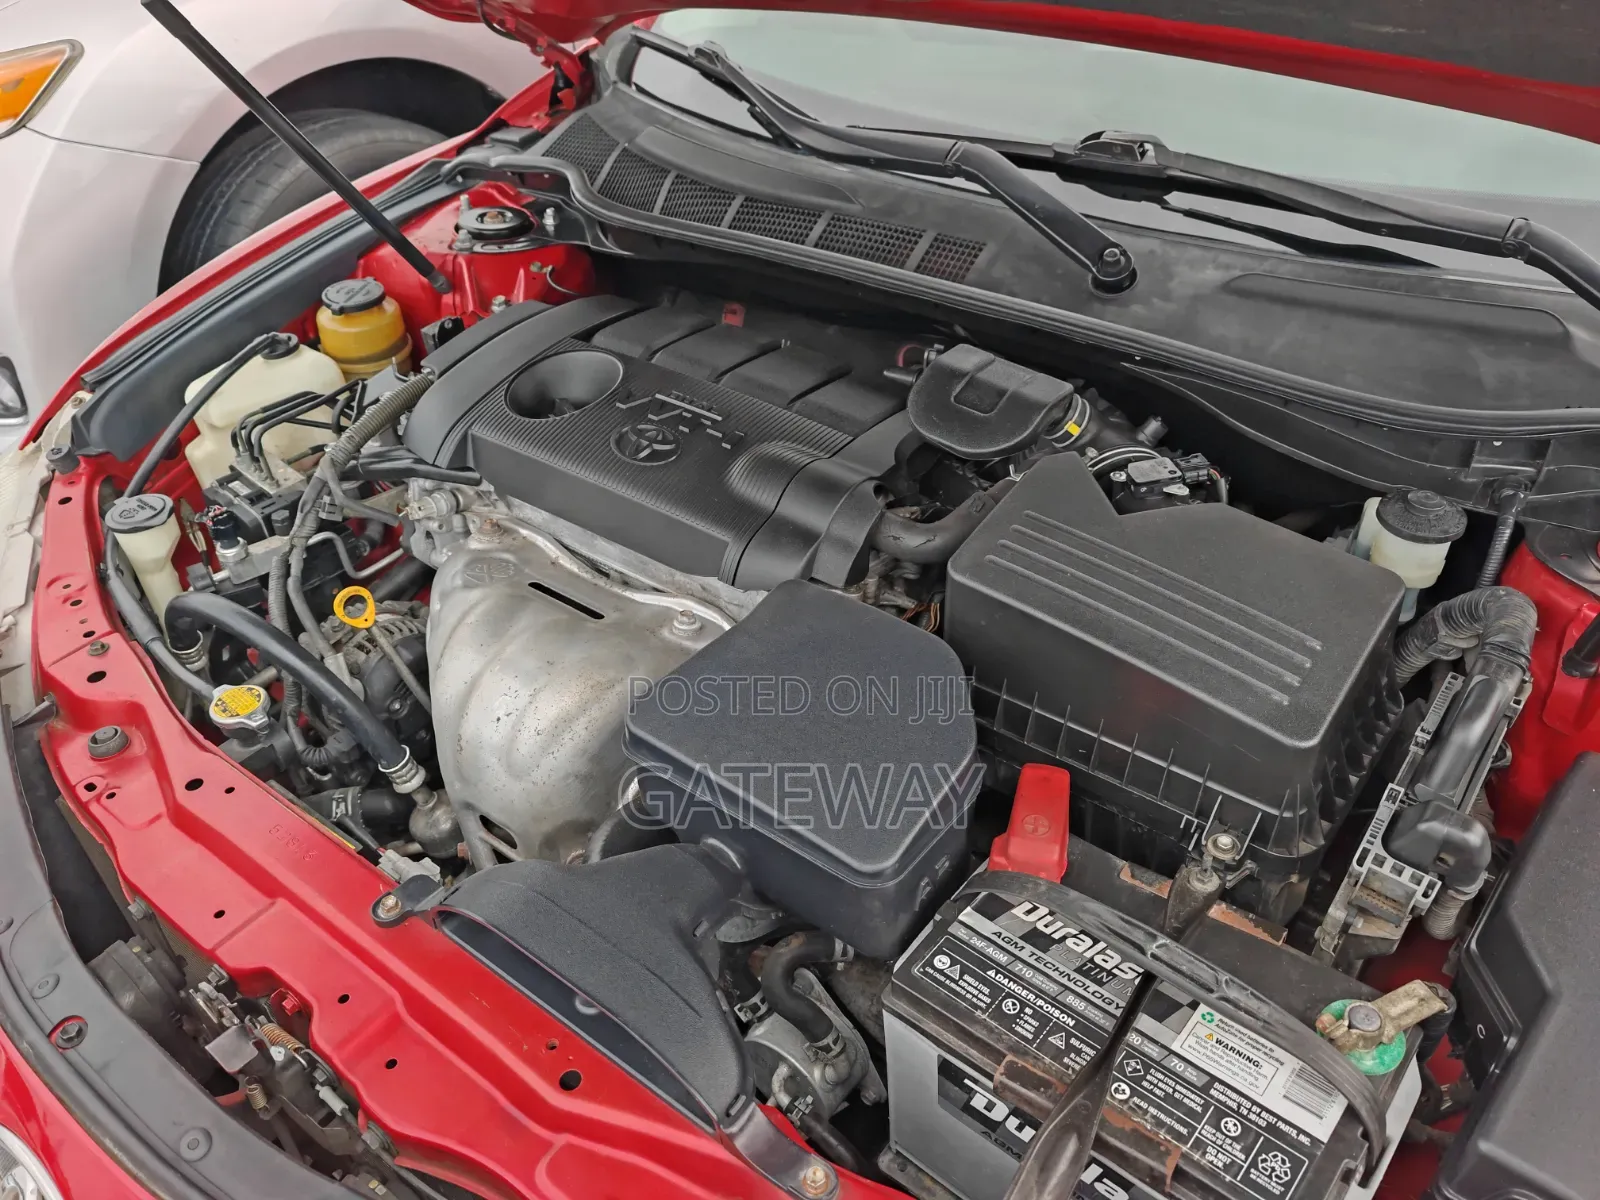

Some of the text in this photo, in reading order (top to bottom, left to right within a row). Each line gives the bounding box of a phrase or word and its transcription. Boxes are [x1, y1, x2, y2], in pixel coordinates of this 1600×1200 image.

[969, 936, 1007, 962] 24F-AGM
[962, 973, 979, 986] SHIELD
[991, 931, 1125, 1014] AGM TECHNOLOGY
[1014, 963, 1033, 977] 710
[957, 979, 991, 1003] EXPLOSIVE GASES
[993, 973, 1075, 1026] DANGER/POISON
[1023, 1006, 1033, 1014] NO
[1066, 995, 1086, 1009] 885
[1018, 1019, 1035, 1032] FLAMES
[1023, 1014, 1039, 1027] SPARKS
[1069, 1037, 1096, 1056] SULFURIC
[1191, 1031, 1209, 1044] Cancer
[1209, 1043, 1220, 1051] and
[1219, 1048, 1252, 1070] Reproductive
[1246, 1034, 1268, 1049] batteries
[1080, 1052, 1091, 1061] CAN
[1194, 1039, 1208, 1051] Wash
[1208, 1048, 1224, 1060] hands
[1224, 1058, 1236, 1067] after
[1215, 1037, 1262, 1069] WARNING:
[1244, 1041, 1262, 1052] proper
[1261, 1050, 1284, 1066] recycling
[1170, 1057, 1184, 1071] 70
[1141, 1080, 1165, 1097] HELP FAST.
[1145, 1074, 1158, 1084] WITH
[1173, 1091, 1183, 1100] GET
[1182, 1097, 1202, 1113] MEDICAL
[1149, 1068, 1204, 1104] FLUSH EYES IMMEDIATELY
[1130, 1096, 1187, 1136] READ INSTRUCTIONS.
[1209, 1087, 1267, 1127] MEMPHIS, TN 38103
[1213, 1081, 1310, 1146] DISTRIBUTED BY BEST PARTS, INC.
[1200, 1128, 1216, 1141] REACH
[1203, 1124, 1216, 1133] KEEP
[1215, 1131, 1225, 1140] OUT
[1231, 1141, 1241, 1150] THE
[1204, 1152, 1227, 1169] OPEN.
[1206, 1145, 1231, 1164] DO NOT
